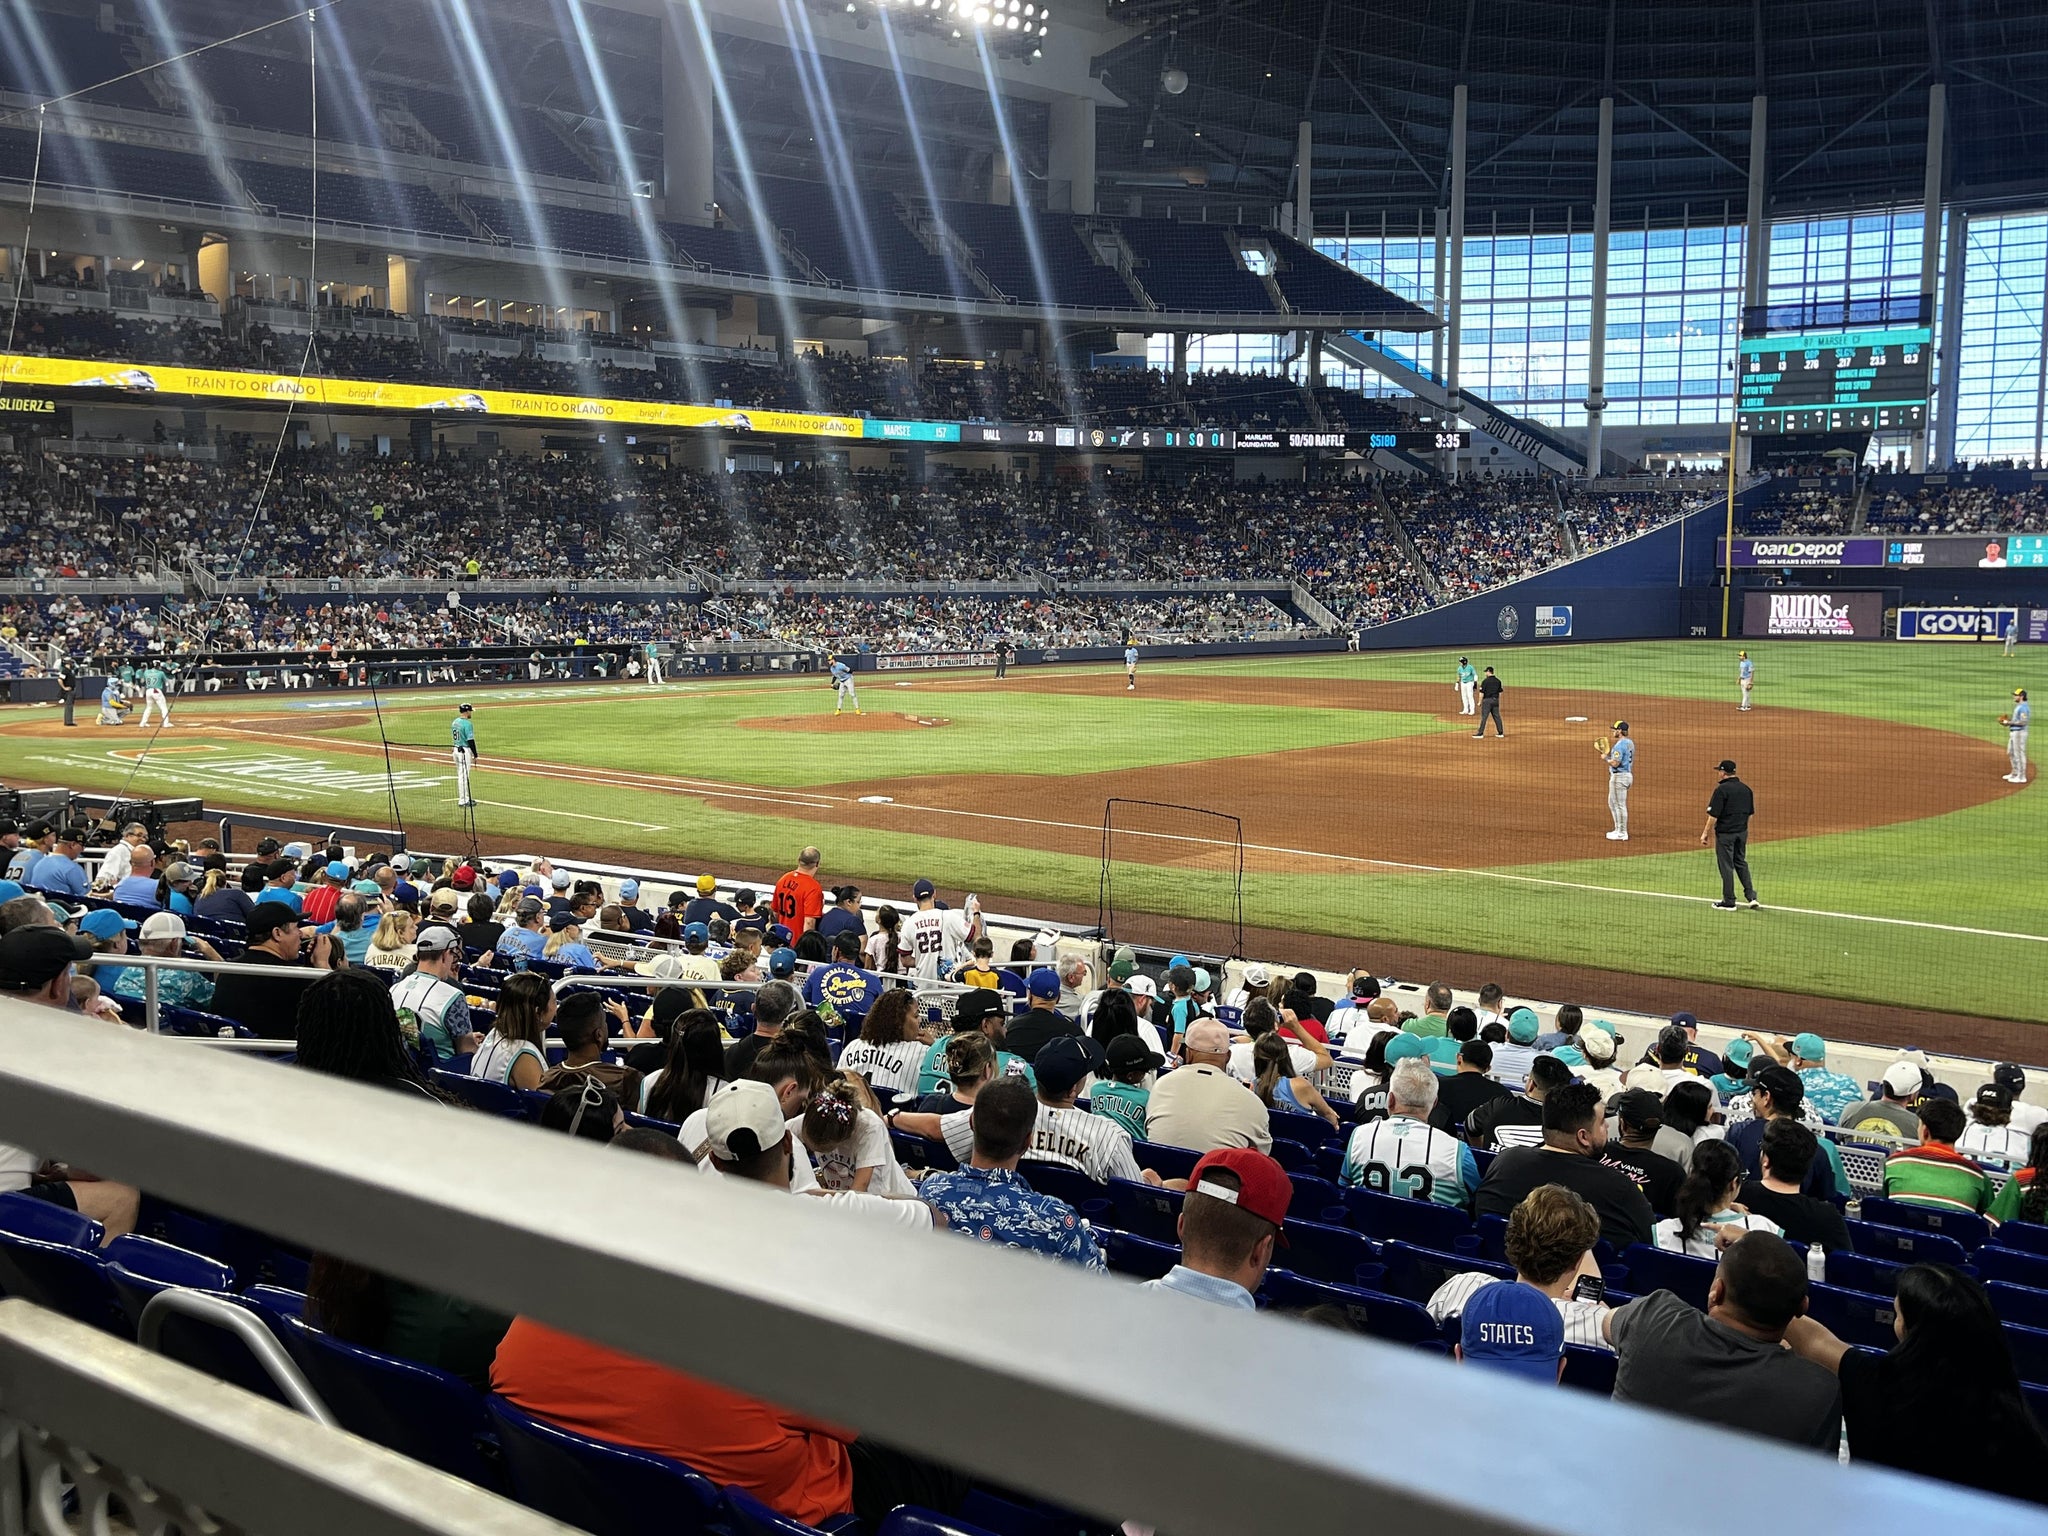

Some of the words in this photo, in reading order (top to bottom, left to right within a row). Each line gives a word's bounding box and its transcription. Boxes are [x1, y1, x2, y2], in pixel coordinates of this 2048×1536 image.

[1818, 336, 1848, 346] MARSEE
[1869, 355, 1886, 366] 23.5
[186, 376, 226, 390] TRAIN
[230, 379, 247, 391] TO
[250, 381, 316, 396] ORLANDO
[511, 399, 542, 411] TRAIN
[545, 402, 558, 411] TO
[561, 402, 614, 415] ORLANDO
[771, 418, 796, 428] TRAIN
[798, 420, 810, 429] TO
[811, 421, 855, 432] ORLANDO
[883, 424, 911, 436] MARSEE
[983, 429, 1000, 441] HALL
[1028, 430, 1043, 442] 2.79
[1142, 432, 1149, 446] 5
[1289, 434, 1314, 446] 50/50
[1314, 434, 1345, 446] RAFFLE
[1435, 433, 1460, 448] 3:35
[1482, 415, 1509, 440] 300
[1507, 429, 1544, 460] LEVEL
[1751, 541, 1845, 558] loanDepot
[1890, 543, 1902, 554] 39
[1903, 543, 1923, 553] EURY
[1832, 604, 1849, 619] of
[1768, 618, 1811, 628] PUERTO
[1813, 619, 1839, 627] RICO
[1920, 614, 1993, 634] GOYA
[1690, 626, 1706, 636] 344
[779, 892, 796, 919] 13
[915, 930, 943, 954] 22
[372, 954, 406, 967] TURANG
[846, 1049, 903, 1074] CASTILLO
[1029, 1131, 1090, 1163] ELICK
[1621, 1163, 1644, 1175] VANS
[1480, 1322, 1534, 1345] STATES
